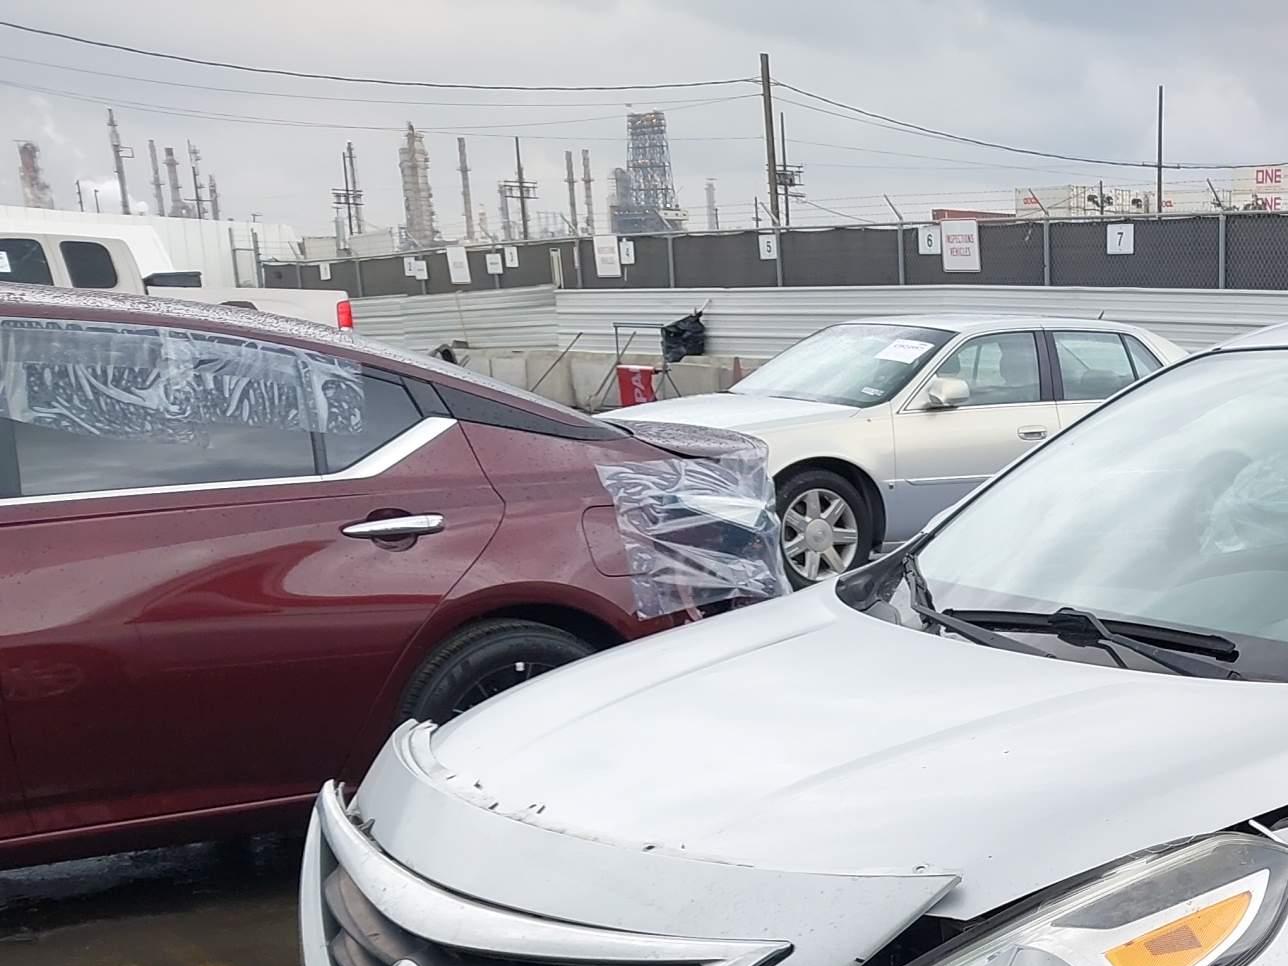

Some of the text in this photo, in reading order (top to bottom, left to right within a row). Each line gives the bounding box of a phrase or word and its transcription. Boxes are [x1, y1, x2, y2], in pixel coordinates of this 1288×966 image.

[1255, 168, 1282, 184] ONE
[926, 233, 934, 248] 6
[1116, 231, 1124, 246] 7
[765, 240, 772, 253] 5
